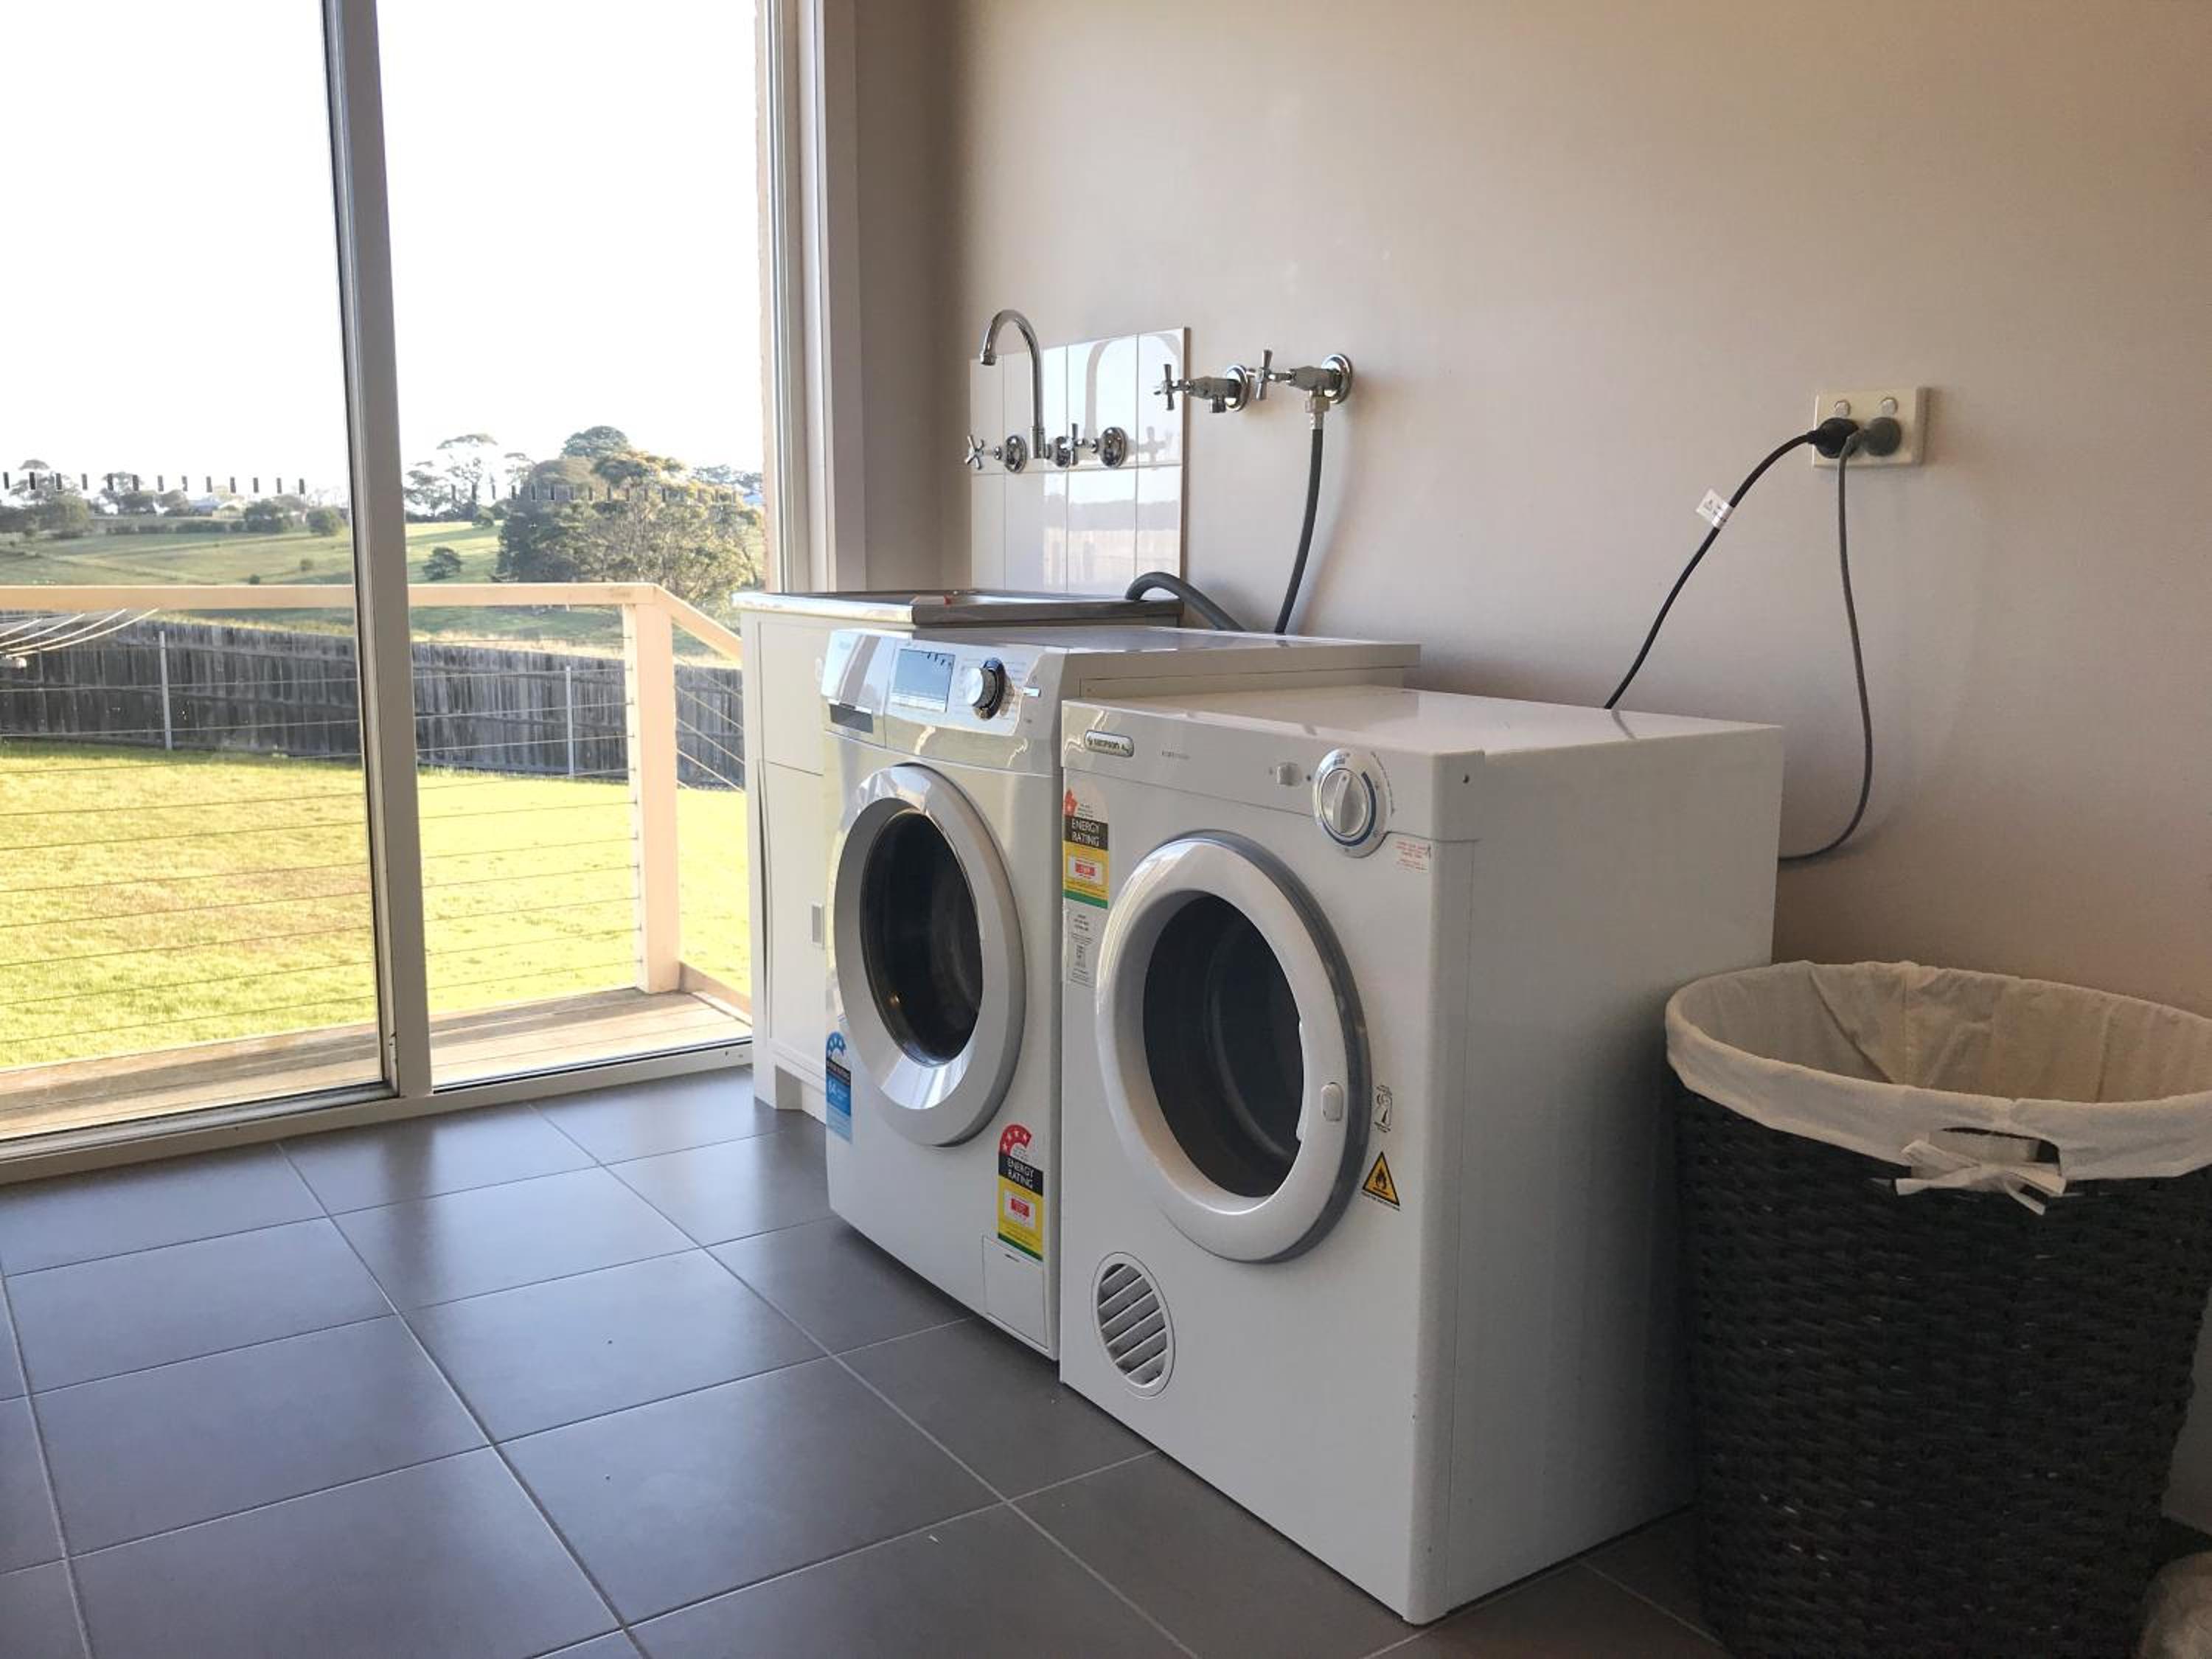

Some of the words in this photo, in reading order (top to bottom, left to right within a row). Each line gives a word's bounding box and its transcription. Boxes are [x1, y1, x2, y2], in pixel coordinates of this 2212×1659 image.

[1071, 818, 1100, 833] ENERGY
[1071, 831, 1100, 846] RATING
[1007, 1157, 1034, 1178] ENERGY
[1007, 1171, 1034, 1189] RATING
